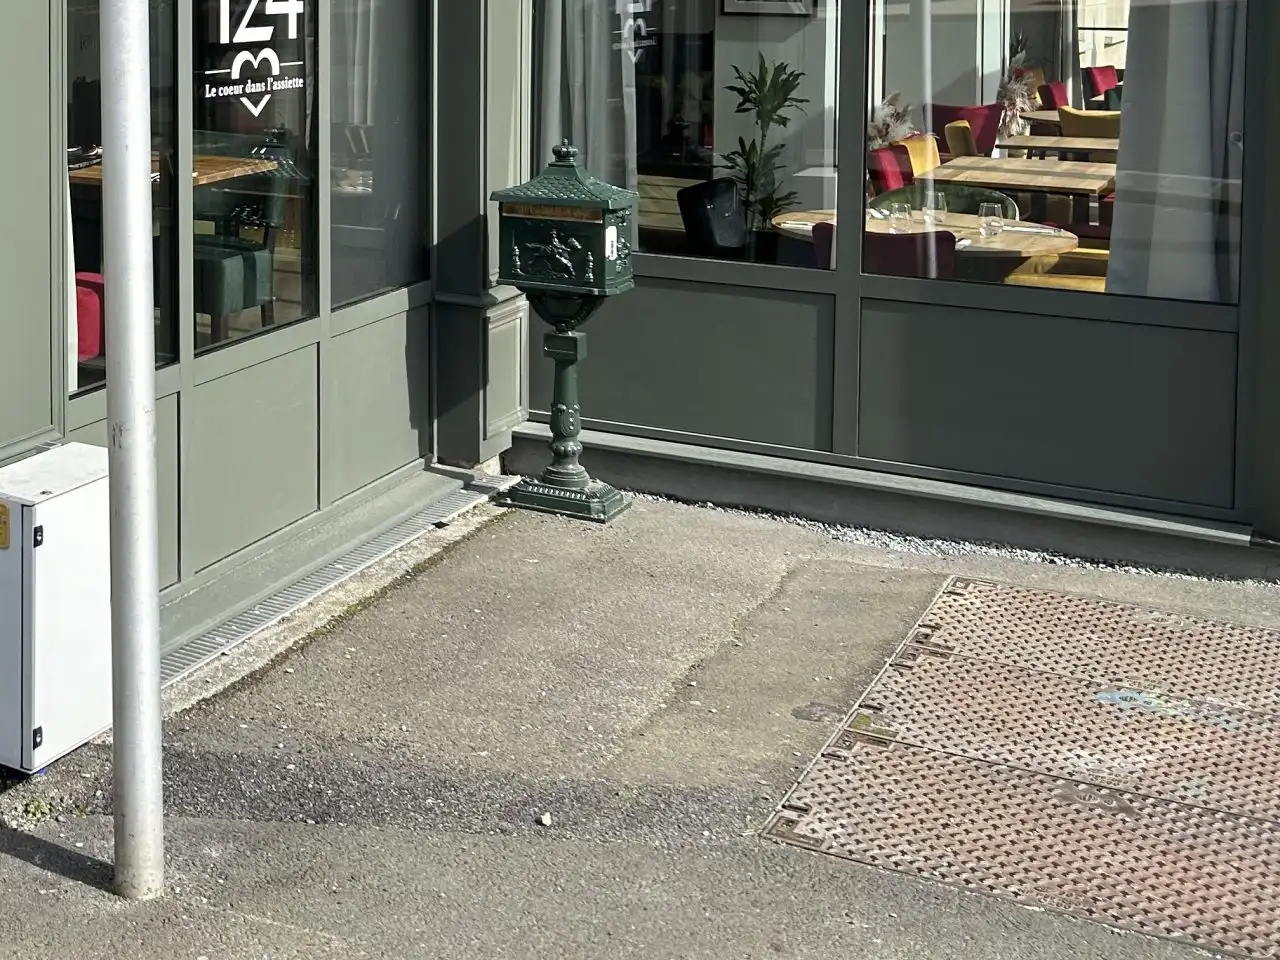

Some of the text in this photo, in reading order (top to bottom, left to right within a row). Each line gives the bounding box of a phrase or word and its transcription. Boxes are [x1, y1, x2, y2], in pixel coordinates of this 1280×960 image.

[205, 84, 216, 98] Le
[218, 84, 243, 96] coeur
[245, 79, 265, 93] dans
